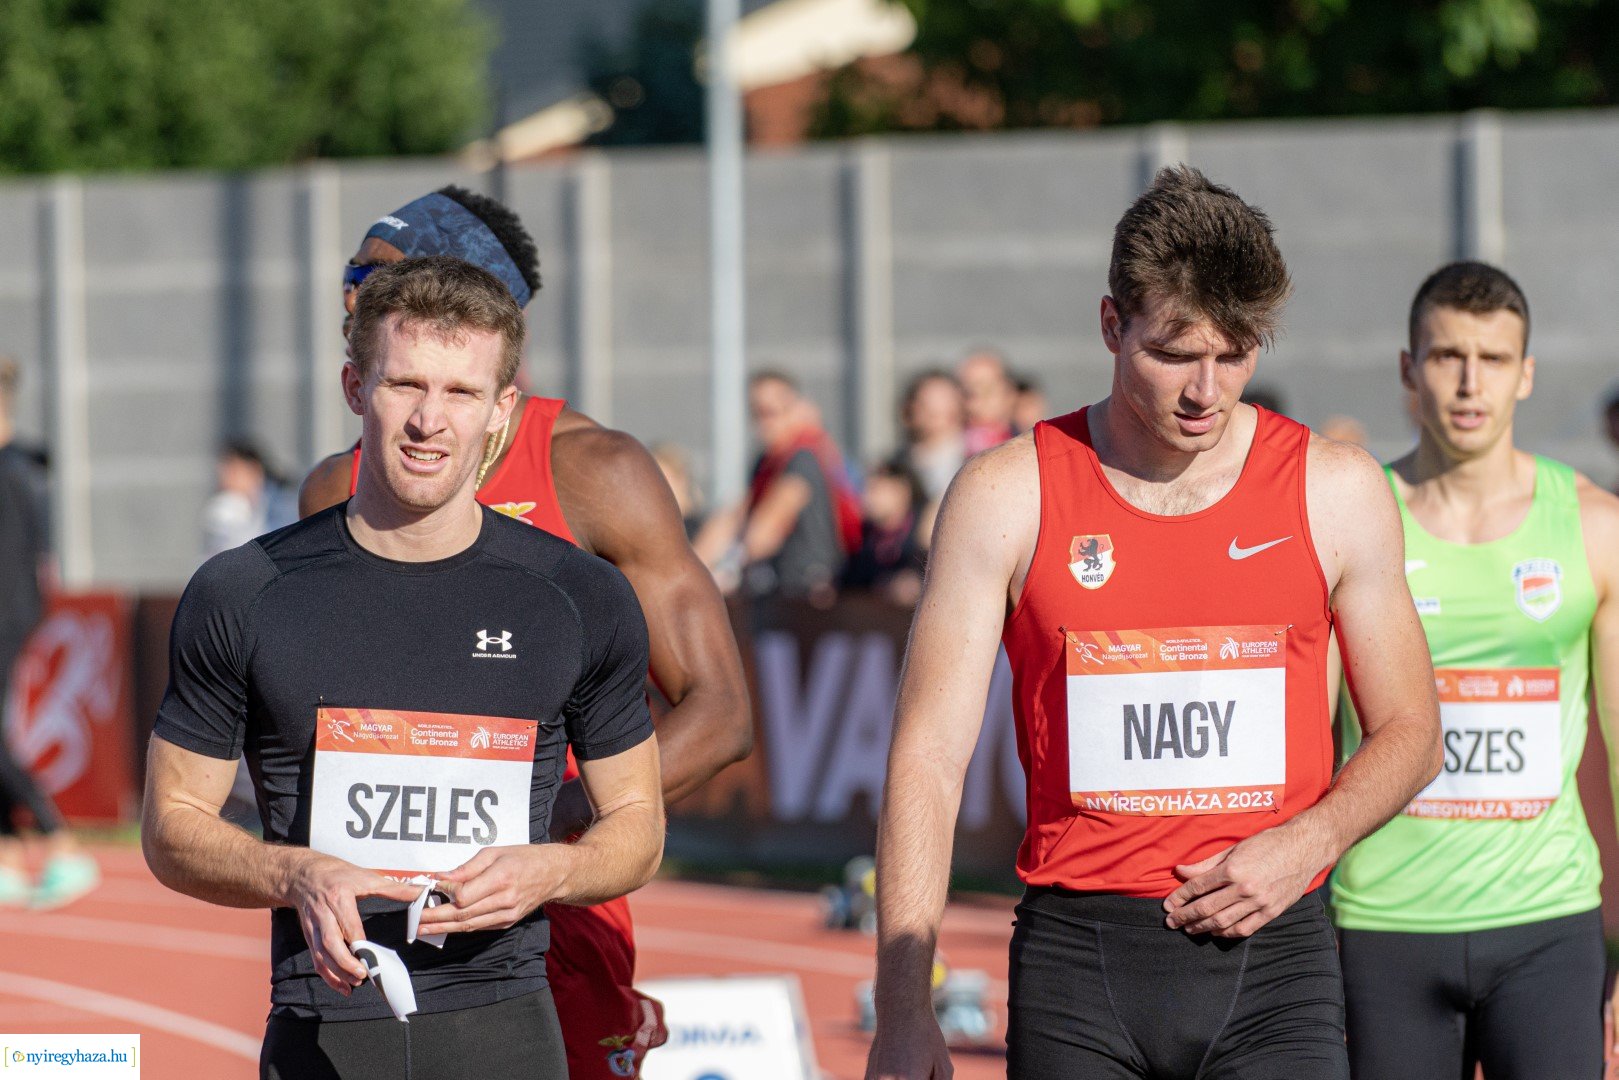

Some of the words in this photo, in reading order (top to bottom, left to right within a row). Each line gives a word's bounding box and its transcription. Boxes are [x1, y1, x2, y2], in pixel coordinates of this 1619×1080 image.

[1081, 572, 1105, 583] HONVÉD
[1108, 644, 1141, 652] MAGYAR
[1159, 643, 1208, 653] Continental
[1159, 652, 1178, 661] Tour
[1179, 651, 1209, 661] Bronze
[360, 723, 393, 732] MAGYAR
[1122, 700, 1236, 761] NAGY
[410, 727, 459, 739] Continental
[493, 732, 529, 741] EUROPEAN
[410, 737, 429, 746] Tour
[429, 738, 459, 747] Bronze
[492, 739, 528, 747] ATHLETICS
[1444, 729, 1525, 773] SZES
[1086, 790, 1223, 812] NYÍREGYHÁZA
[1226, 790, 1274, 809] 2023
[345, 782, 499, 846] SZELES
